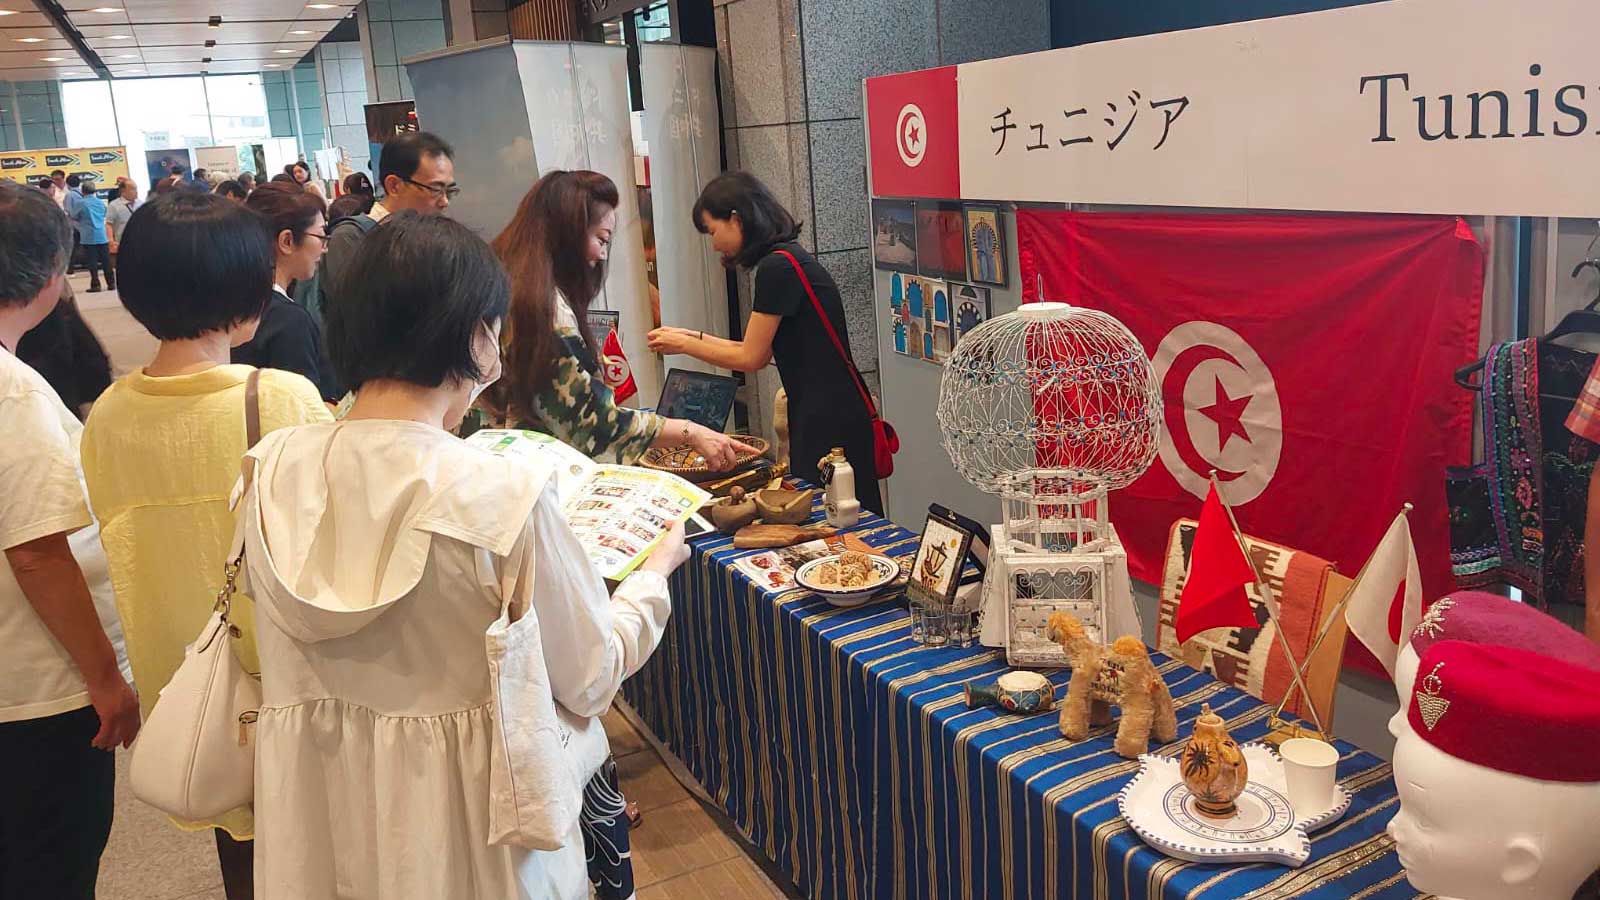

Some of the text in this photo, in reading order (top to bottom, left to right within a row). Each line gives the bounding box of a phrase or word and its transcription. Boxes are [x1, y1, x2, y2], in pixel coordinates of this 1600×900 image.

[990, 89, 1190, 156] チュニジア
[1359, 63, 1600, 142] Tunis
